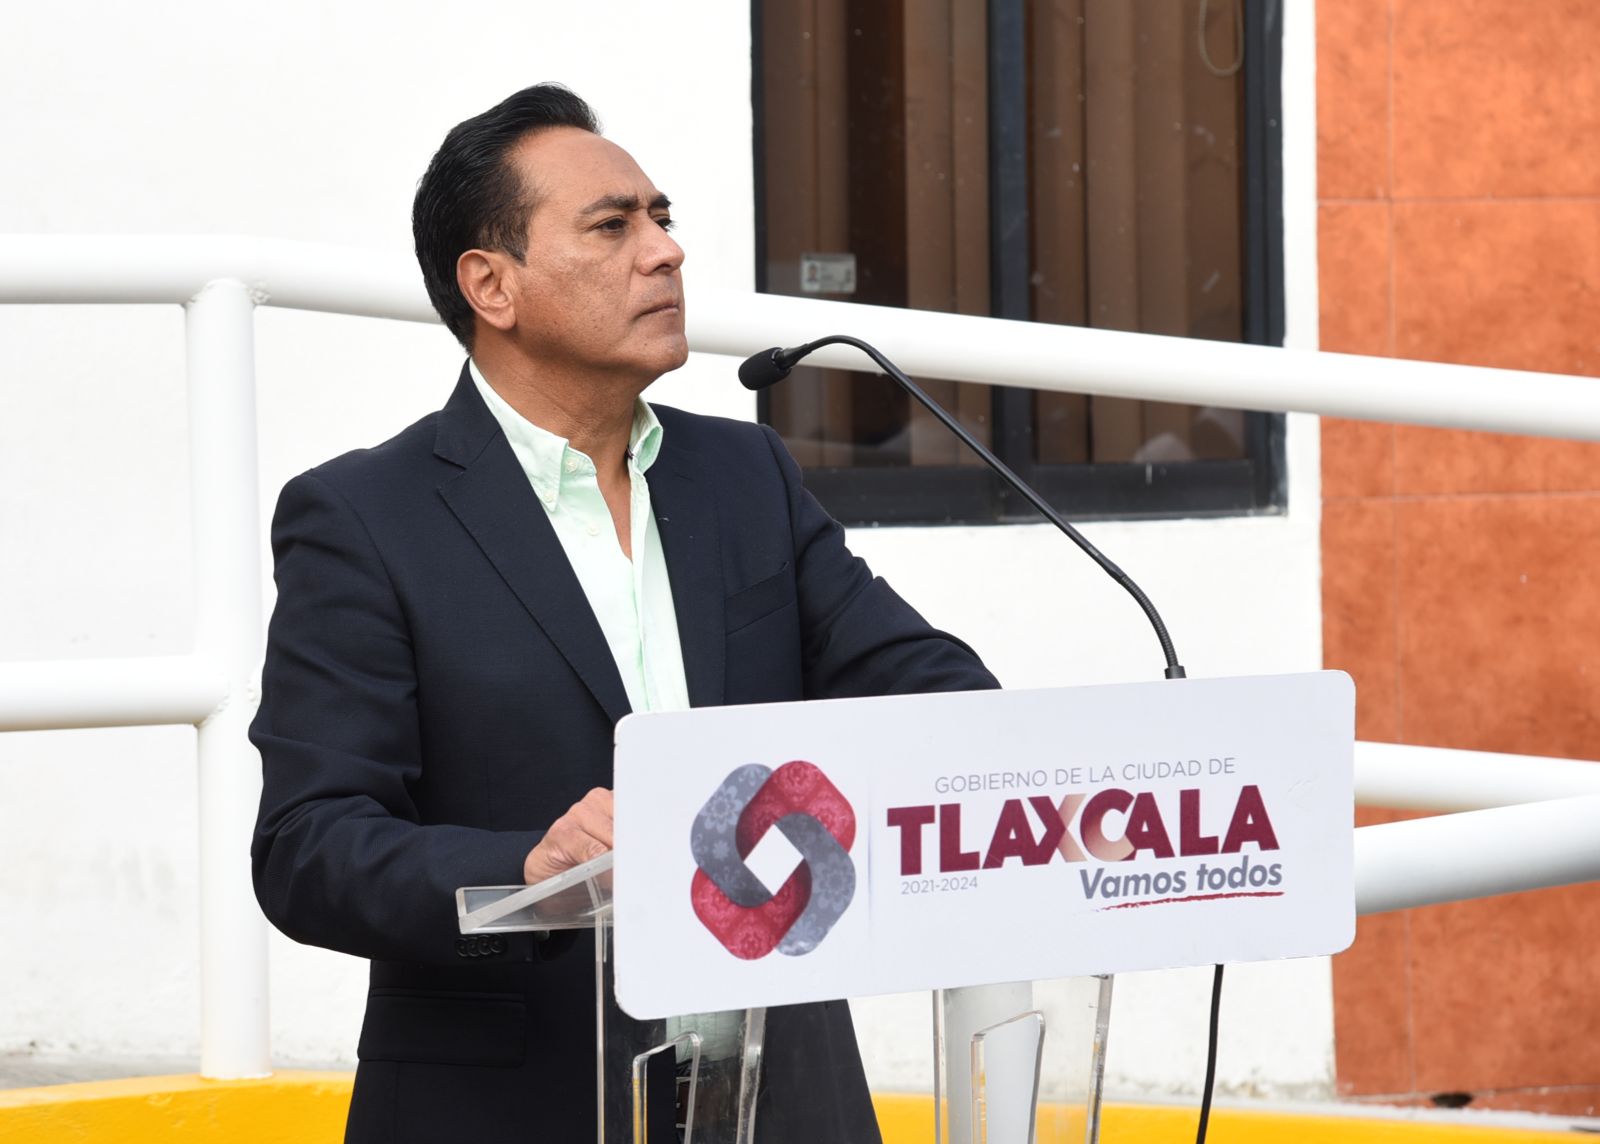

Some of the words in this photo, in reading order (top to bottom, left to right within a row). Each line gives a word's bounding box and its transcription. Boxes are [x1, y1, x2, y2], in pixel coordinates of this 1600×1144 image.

[934, 770, 1048, 794] GOBIERNO
[1054, 767, 1083, 785] DE
[1089, 765, 1116, 783] LA
[1122, 759, 1201, 780] CIUDAD
[1209, 757, 1236, 775] DE
[887, 784, 1280, 876] TLAXCALA
[900, 876, 979, 895] 2021-2024
[1080, 867, 1187, 899] Vamos
[1196, 855, 1283, 891] todos
